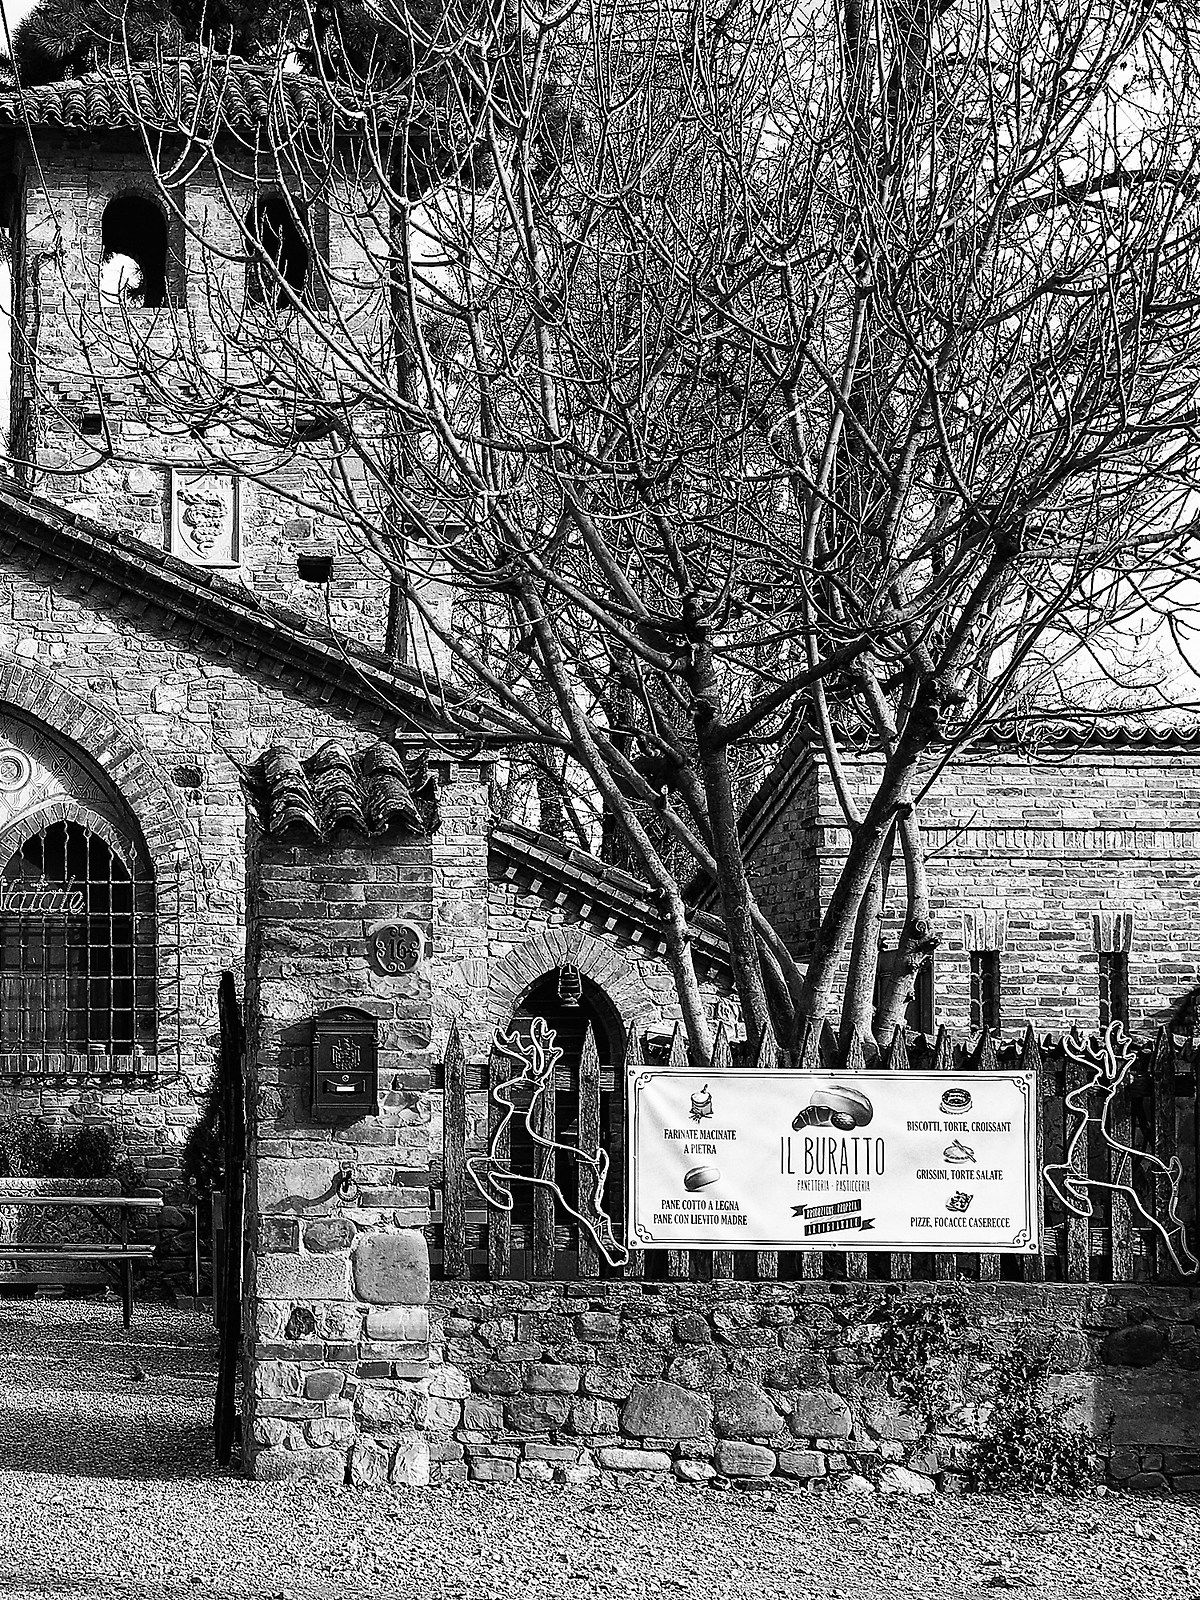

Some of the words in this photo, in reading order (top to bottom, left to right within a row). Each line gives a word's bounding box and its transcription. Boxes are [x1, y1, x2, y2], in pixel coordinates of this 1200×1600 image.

[387, 938, 407, 961] 16
[906, 1120, 942, 1132] BISCOTTI,
[943, 1121, 969, 1133] TORTE,
[971, 1121, 1011, 1132] CROISSANT
[663, 1128, 698, 1139] FARINATE
[699, 1129, 737, 1140] MACINATE
[683, 1144, 689, 1154] A
[690, 1144, 717, 1154] PIETRA
[780, 1136, 795, 1175] IL
[804, 1136, 885, 1176] BURATTO
[916, 1169, 949, 1180] GRISSINI,
[950, 1169, 975, 1180] TORTE
[976, 1169, 1003, 1180] SALATE
[661, 1200, 681, 1210] PANE
[681, 1200, 707, 1210] COTTO
[708, 1200, 714, 1210] A
[715, 1200, 740, 1211] LEGNA
[653, 1213, 673, 1224] PANE
[673, 1214, 690, 1224] CON
[690, 1214, 719, 1225] LIEVITO
[720, 1214, 748, 1225] MADRE
[910, 1217, 932, 1228] PIZZE,
[934, 1217, 967, 1228] FOCACCE
[968, 1217, 1011, 1228] CASERECCE
